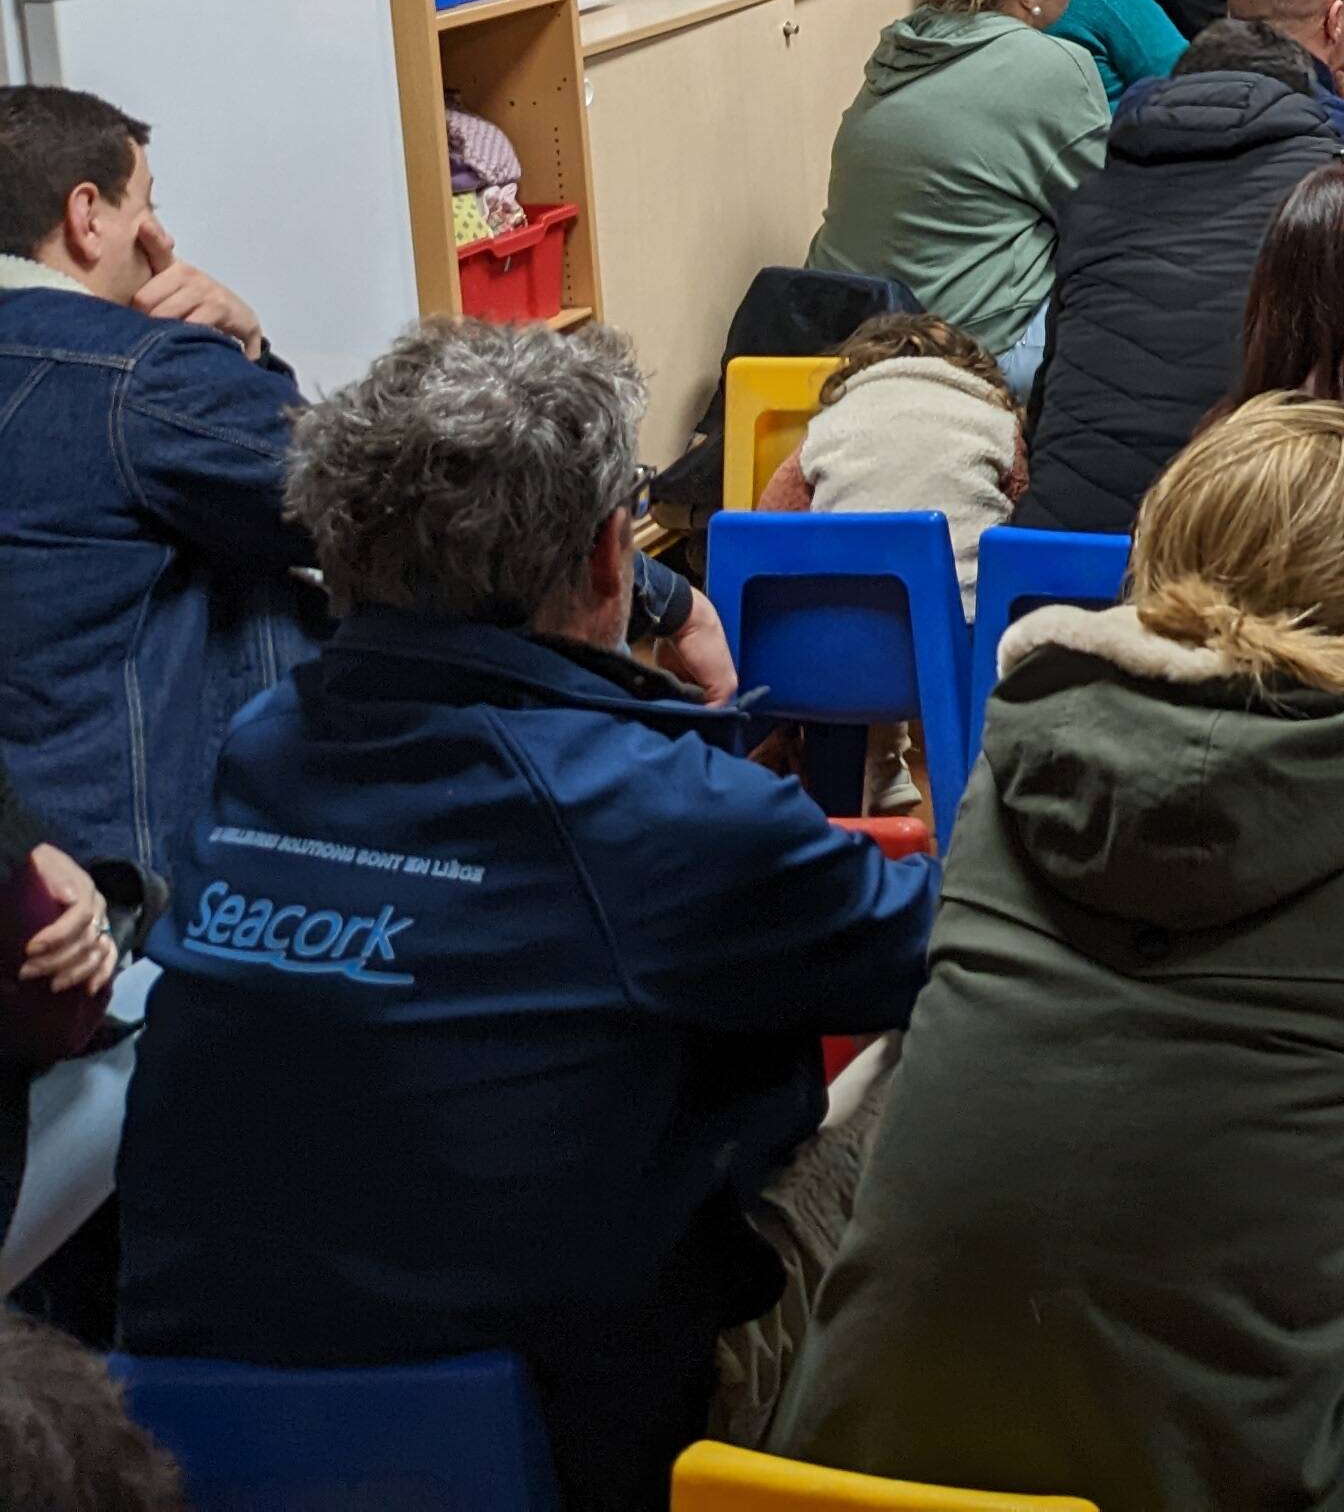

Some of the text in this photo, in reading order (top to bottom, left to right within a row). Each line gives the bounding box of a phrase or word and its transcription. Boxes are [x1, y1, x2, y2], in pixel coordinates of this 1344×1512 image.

[276, 835, 356, 863] SOLUTIONS
[355, 848, 404, 870] SONT
[403, 855, 430, 874] EN
